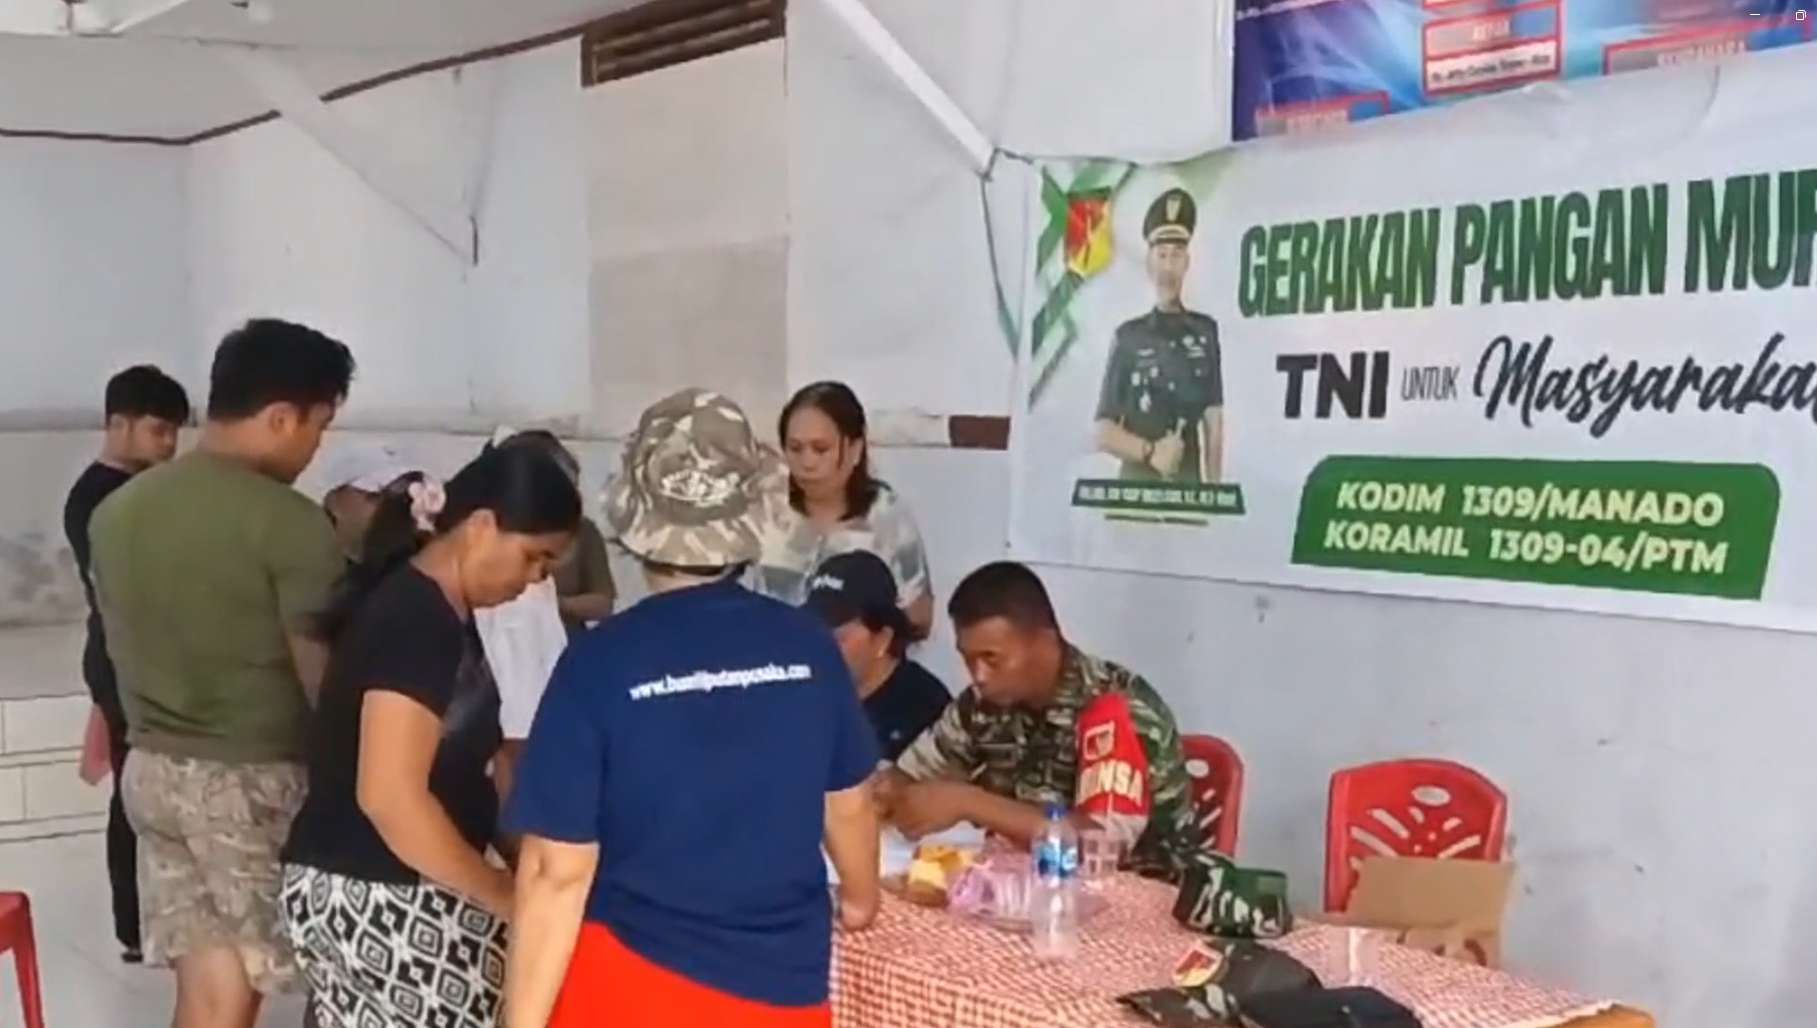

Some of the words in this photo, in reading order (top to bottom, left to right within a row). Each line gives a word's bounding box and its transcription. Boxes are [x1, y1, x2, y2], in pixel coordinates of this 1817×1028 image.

[1238, 207, 1440, 318] GERAKAN
[1451, 182, 1669, 306] PANGAN
[1276, 351, 1390, 420] TNI
[1401, 366, 1460, 401] UNTUK
[1473, 332, 1817, 438] Masyaraka
[1337, 481, 1445, 513] KODIM
[1462, 484, 1725, 527] 1309/MANADO
[1324, 520, 1469, 557] KORAMIL
[1489, 528, 1729, 574] 1309-04/PTM
